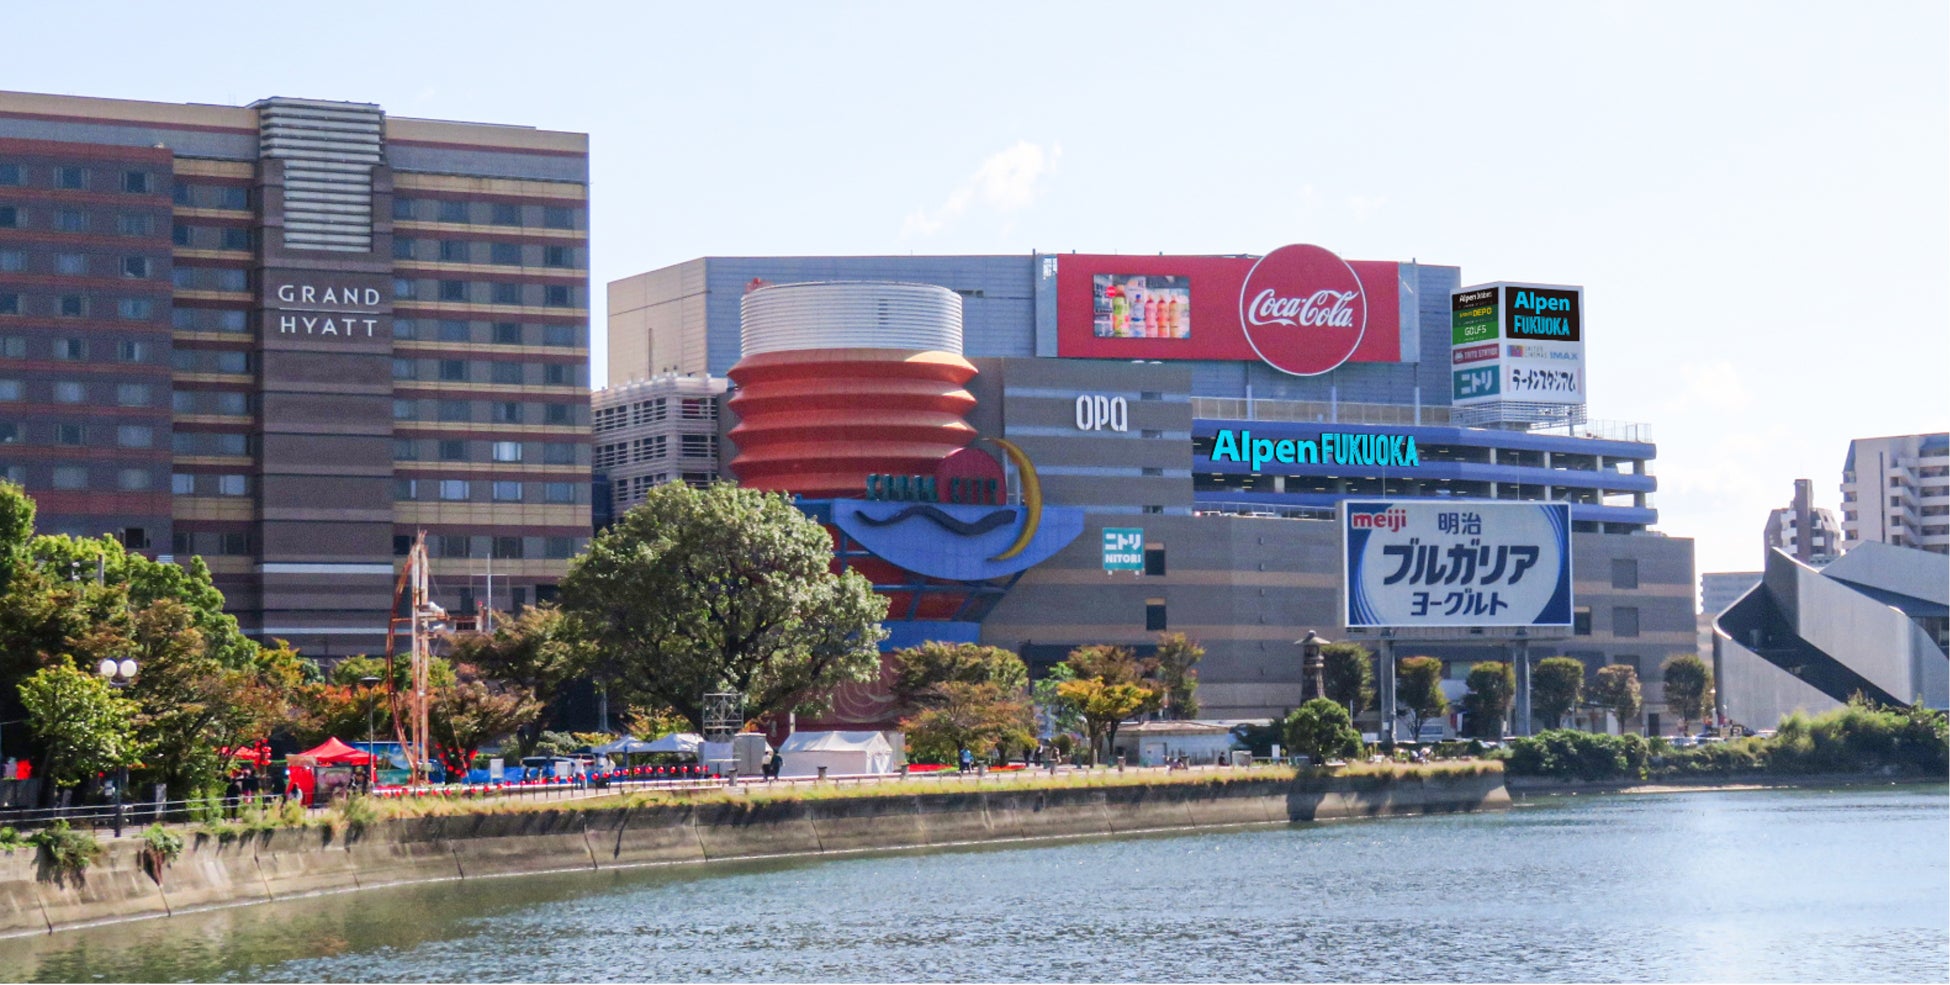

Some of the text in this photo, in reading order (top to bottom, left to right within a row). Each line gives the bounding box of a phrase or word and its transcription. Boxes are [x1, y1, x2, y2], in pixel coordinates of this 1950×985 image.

[278, 284, 380, 306] GRAND
[1459, 293, 1477, 304] Alpen
[1514, 291, 1571, 315] Alpen
[1248, 288, 1360, 328] Coca-Cola
[1472, 306, 1493, 317] DEPO
[280, 316, 378, 337] HYATT
[1514, 314, 1571, 337] FUKUOKA
[1549, 351, 1578, 361] IMAX
[1461, 370, 1493, 396] ニトリ
[1512, 368, 1576, 393] ラーメンスタジアム
[1352, 508, 1407, 533] meiji
[1438, 511, 1482, 535] 明治
[1105, 533, 1142, 551] ニトリ
[1105, 553, 1142, 564] NITORI
[1383, 538, 1540, 586] ブルガリア
[1410, 588, 1508, 616] ヨーグルト
